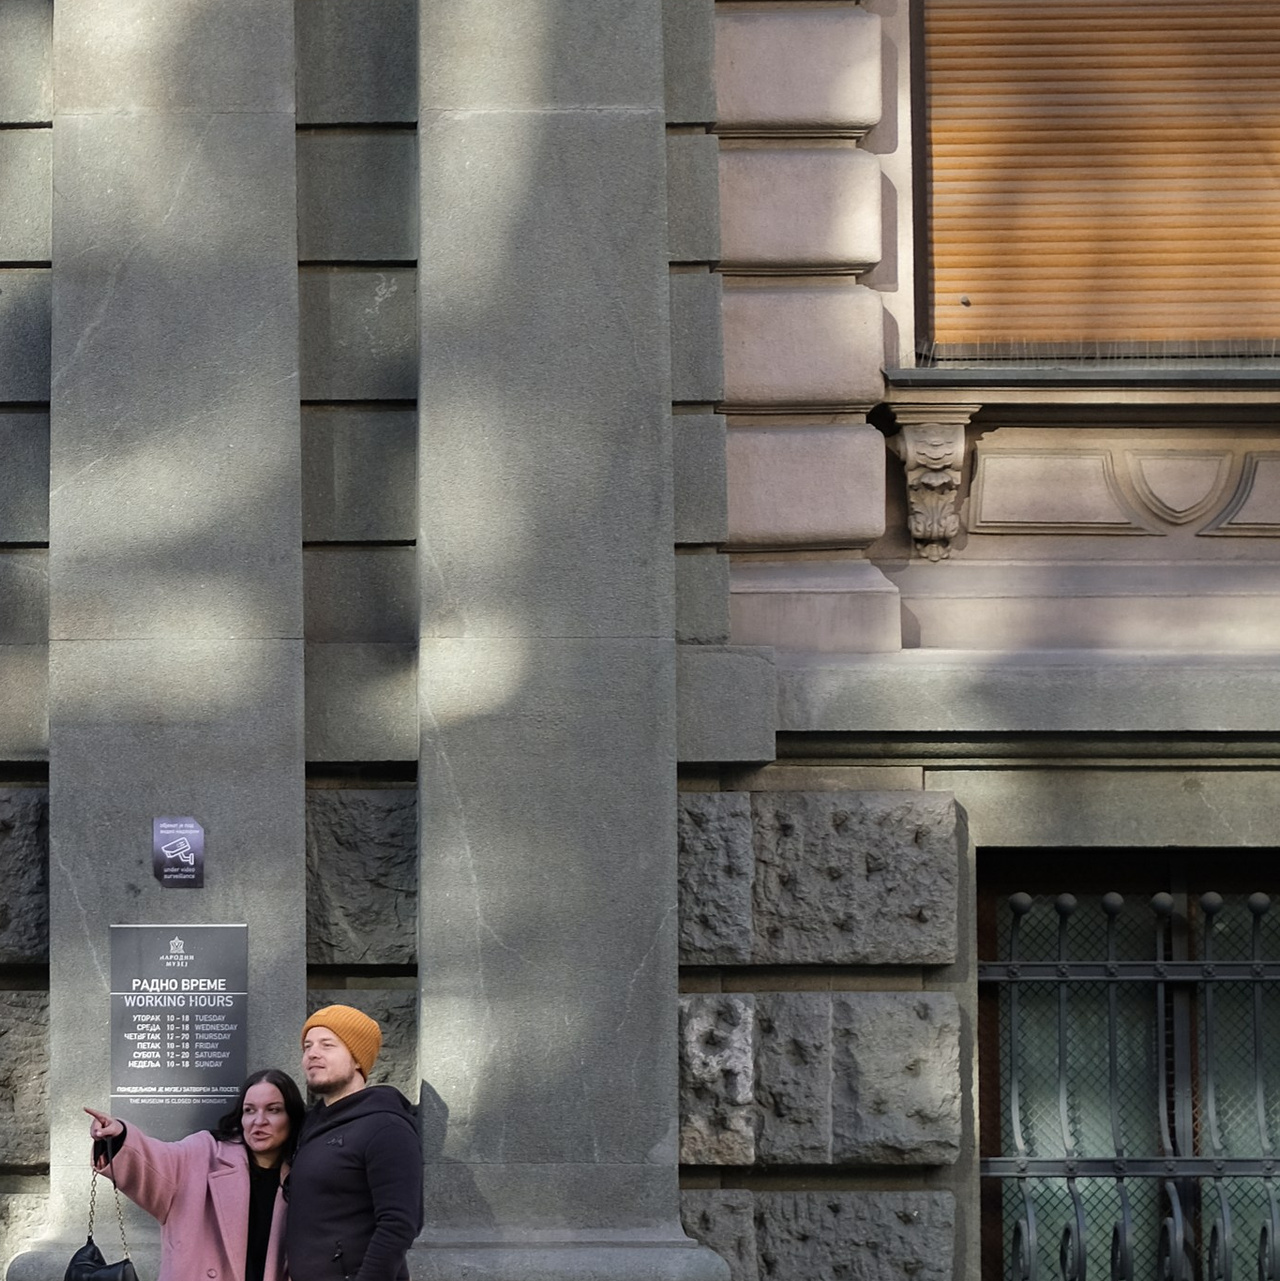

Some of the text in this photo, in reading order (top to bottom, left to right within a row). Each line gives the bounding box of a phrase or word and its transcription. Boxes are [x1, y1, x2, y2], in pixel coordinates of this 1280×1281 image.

[132, 979, 227, 992] РАДНО ВРЕМЕ
[124, 995, 234, 1007] WORKING HOURS
